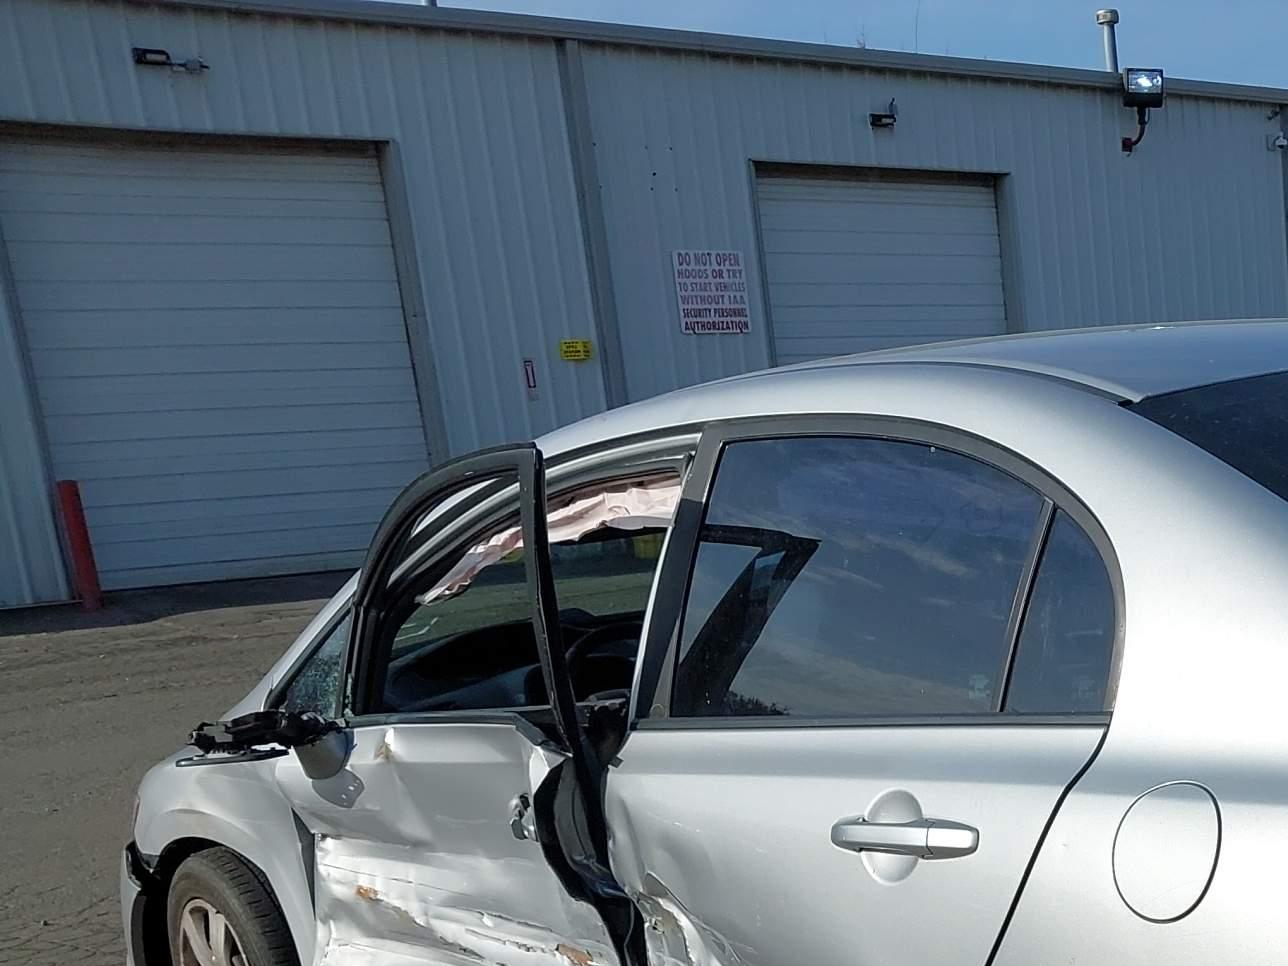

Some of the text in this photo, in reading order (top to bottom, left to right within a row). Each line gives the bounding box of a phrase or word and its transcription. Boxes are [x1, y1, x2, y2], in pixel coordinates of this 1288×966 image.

[677, 252, 740, 267] DO NOT OPEN
[677, 268, 743, 280] HOODS OR TRY
[677, 281, 746, 292] TO START VEHICLES
[680, 294, 746, 305] WITHOUT IAA
[682, 307, 748, 319] SECURITY PERSONNEL
[684, 320, 750, 331] AUTHORIZATION
